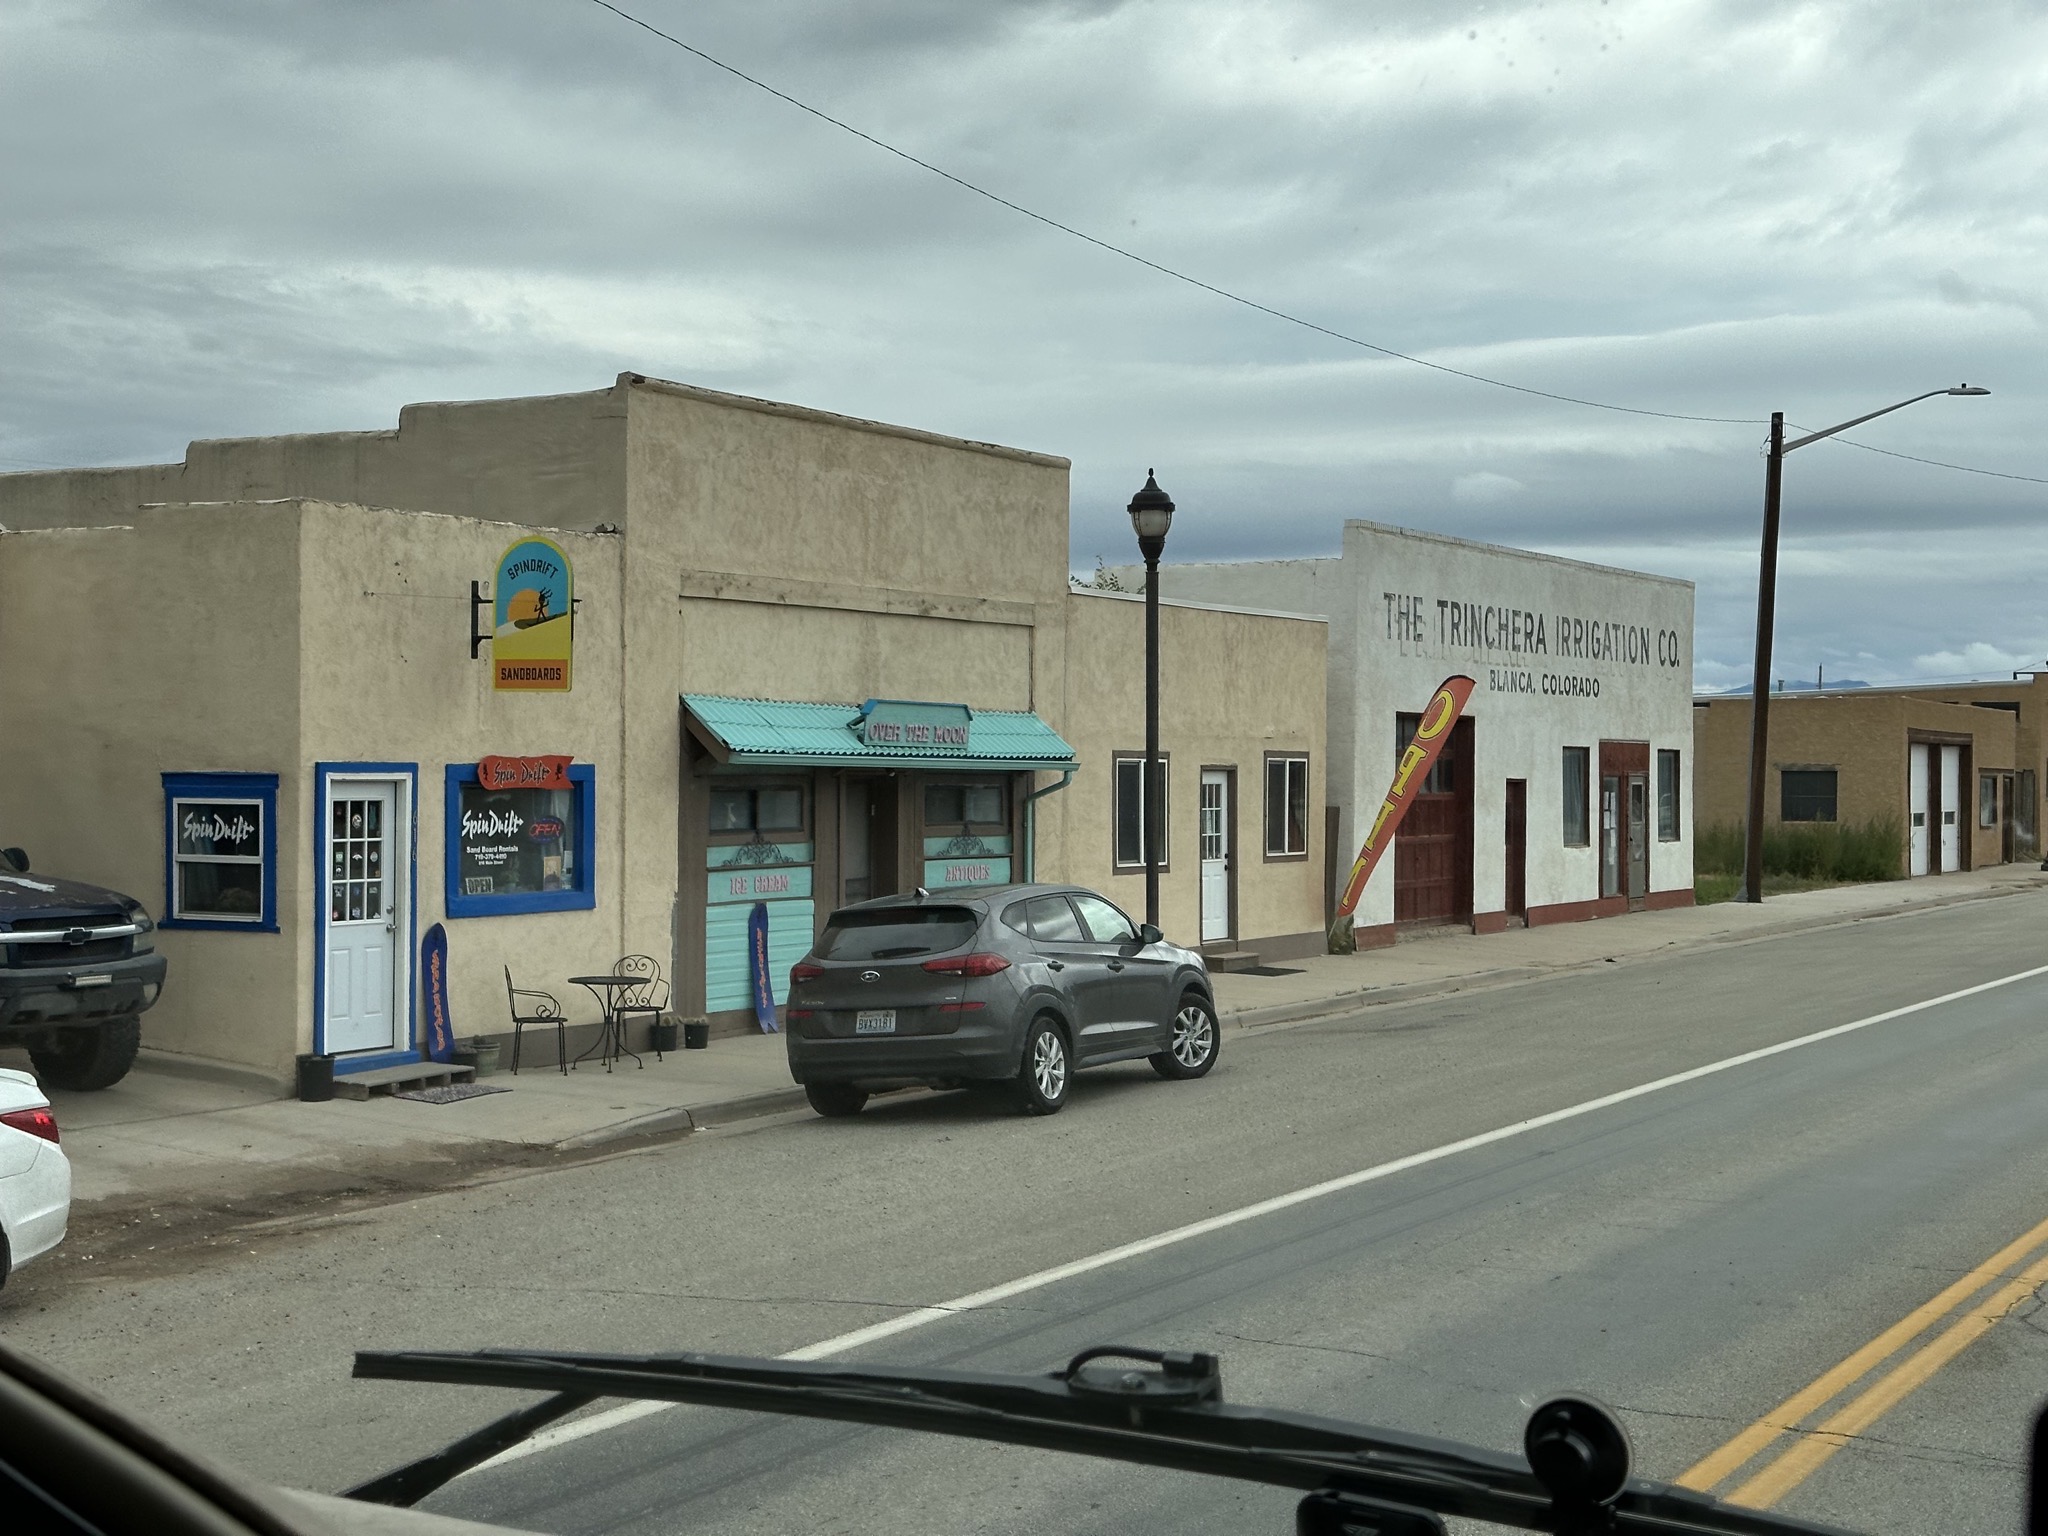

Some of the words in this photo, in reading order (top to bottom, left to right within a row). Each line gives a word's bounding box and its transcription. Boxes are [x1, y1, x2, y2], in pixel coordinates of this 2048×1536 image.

[507, 558, 559, 580] SPINDRIFT
[1383, 592, 1424, 642] THE
[1437, 599, 1548, 655] TRINCHERA
[1556, 615, 1650, 666] IRRIGATION
[1658, 629, 1680, 668] CO.
[501, 667, 562, 681] SANDBOARDS
[1489, 669, 1536, 696] BLANCA,
[1542, 674, 1600, 698] COLORADO
[868, 723, 901, 742] OVER
[905, 723, 930, 743] THE
[933, 725, 967, 744] MOON
[493, 760, 516, 787] Spin
[520, 760, 551, 784] Drift
[183, 811, 255, 845] SpinDrift
[461, 809, 523, 840] SpinDrift
[529, 822, 562, 838] OPEN
[466, 846, 480, 854] Sand
[481, 845, 498, 853] Board
[498, 844, 519, 852] Rentals
[945, 864, 991, 883] ANTIQUES
[467, 878, 492, 894] OPEN
[730, 876, 748, 895] ICE
[753, 874, 789, 894] CREAM
